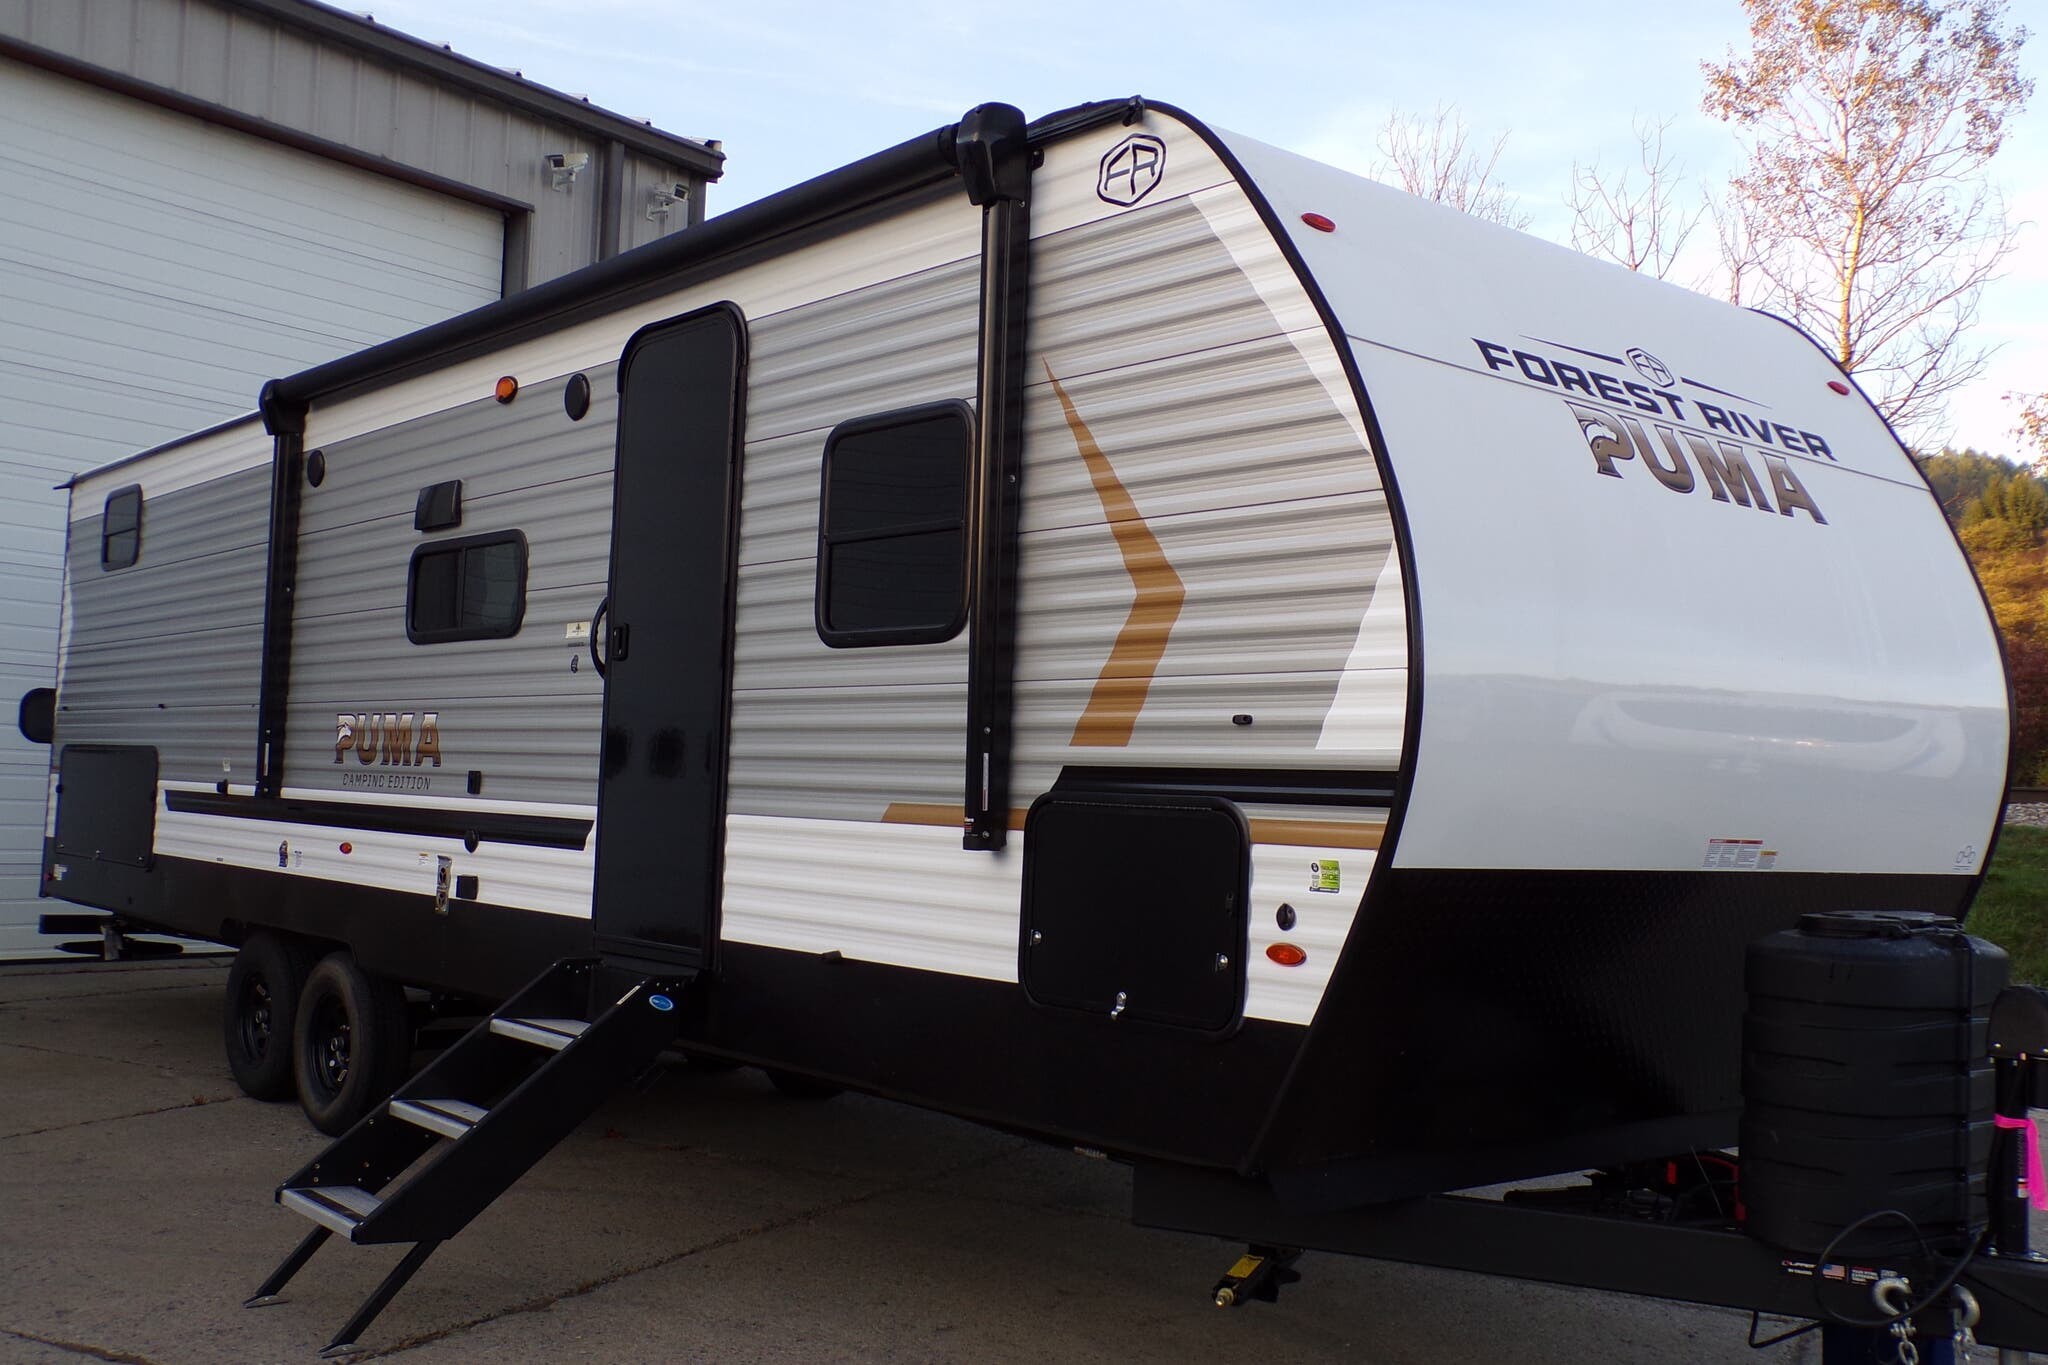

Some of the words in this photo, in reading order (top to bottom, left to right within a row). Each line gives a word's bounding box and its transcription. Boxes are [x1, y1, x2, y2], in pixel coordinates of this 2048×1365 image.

[1471, 337, 1686, 421] FOREST
[1693, 399, 1840, 462] RIVER
[1563, 399, 1830, 526] PUMA
[334, 711, 442, 768] PUMA
[342, 773, 385, 788] CAMPING
[388, 775, 431, 790] EDITION
